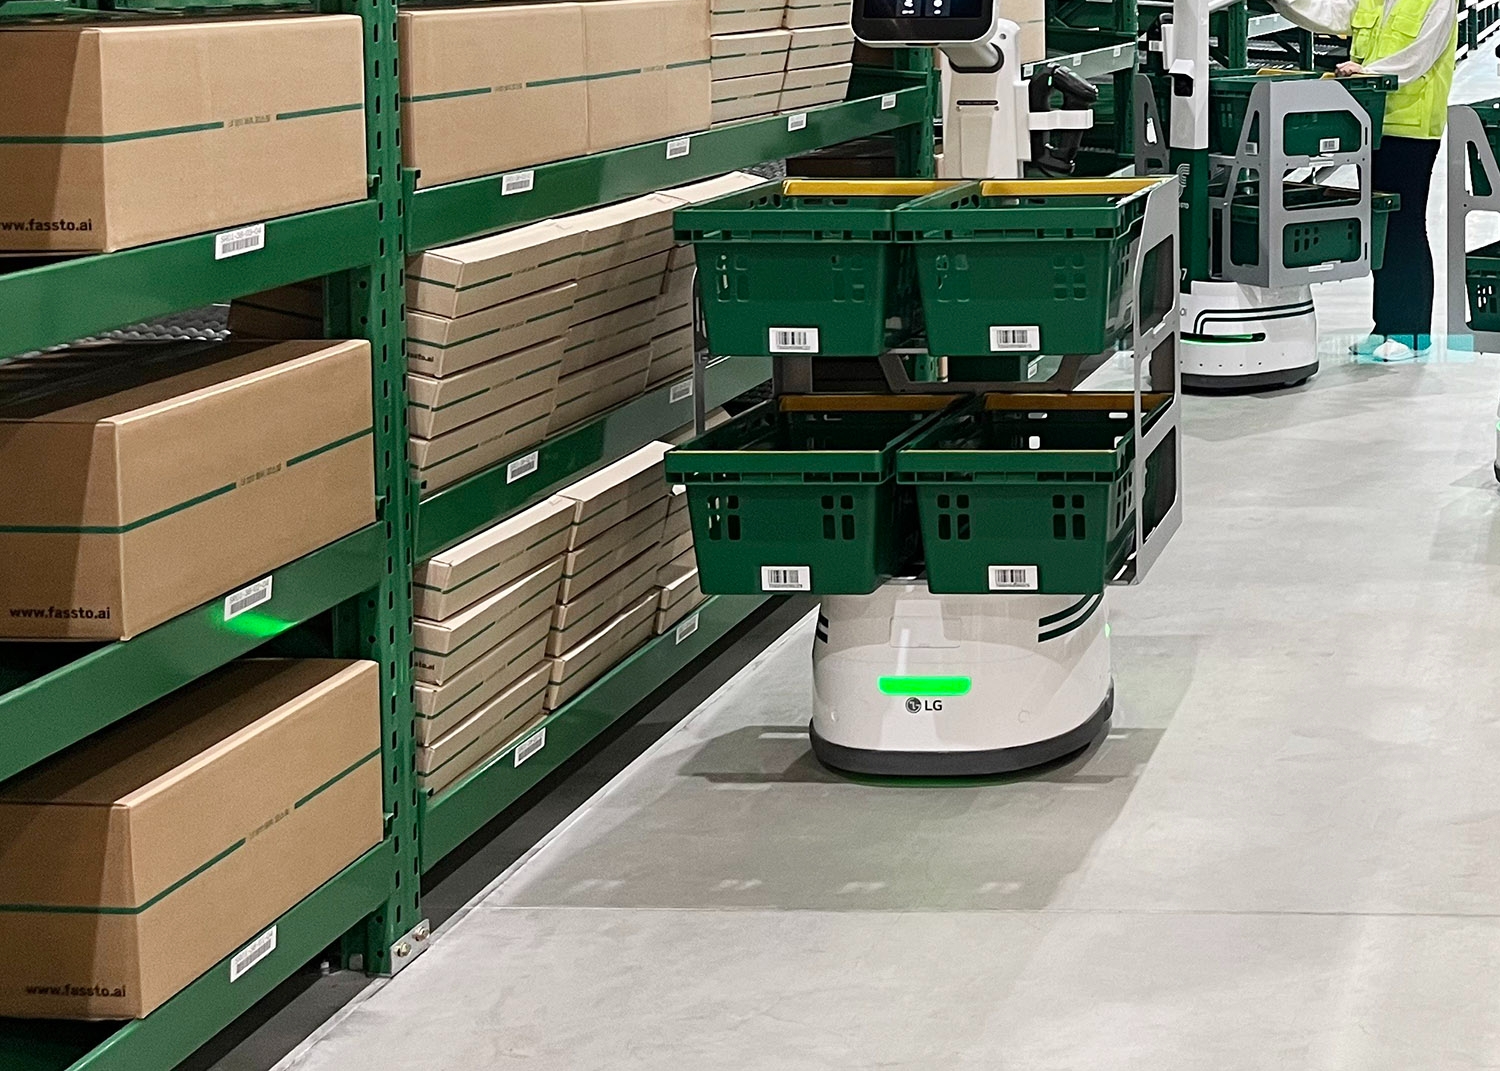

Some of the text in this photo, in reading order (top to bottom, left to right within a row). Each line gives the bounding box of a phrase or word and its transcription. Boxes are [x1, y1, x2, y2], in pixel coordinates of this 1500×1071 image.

[0, 218, 93, 232] ww.fassto.ai
[9, 607, 110, 619] www.fassto.ai
[925, 700, 943, 711] LG
